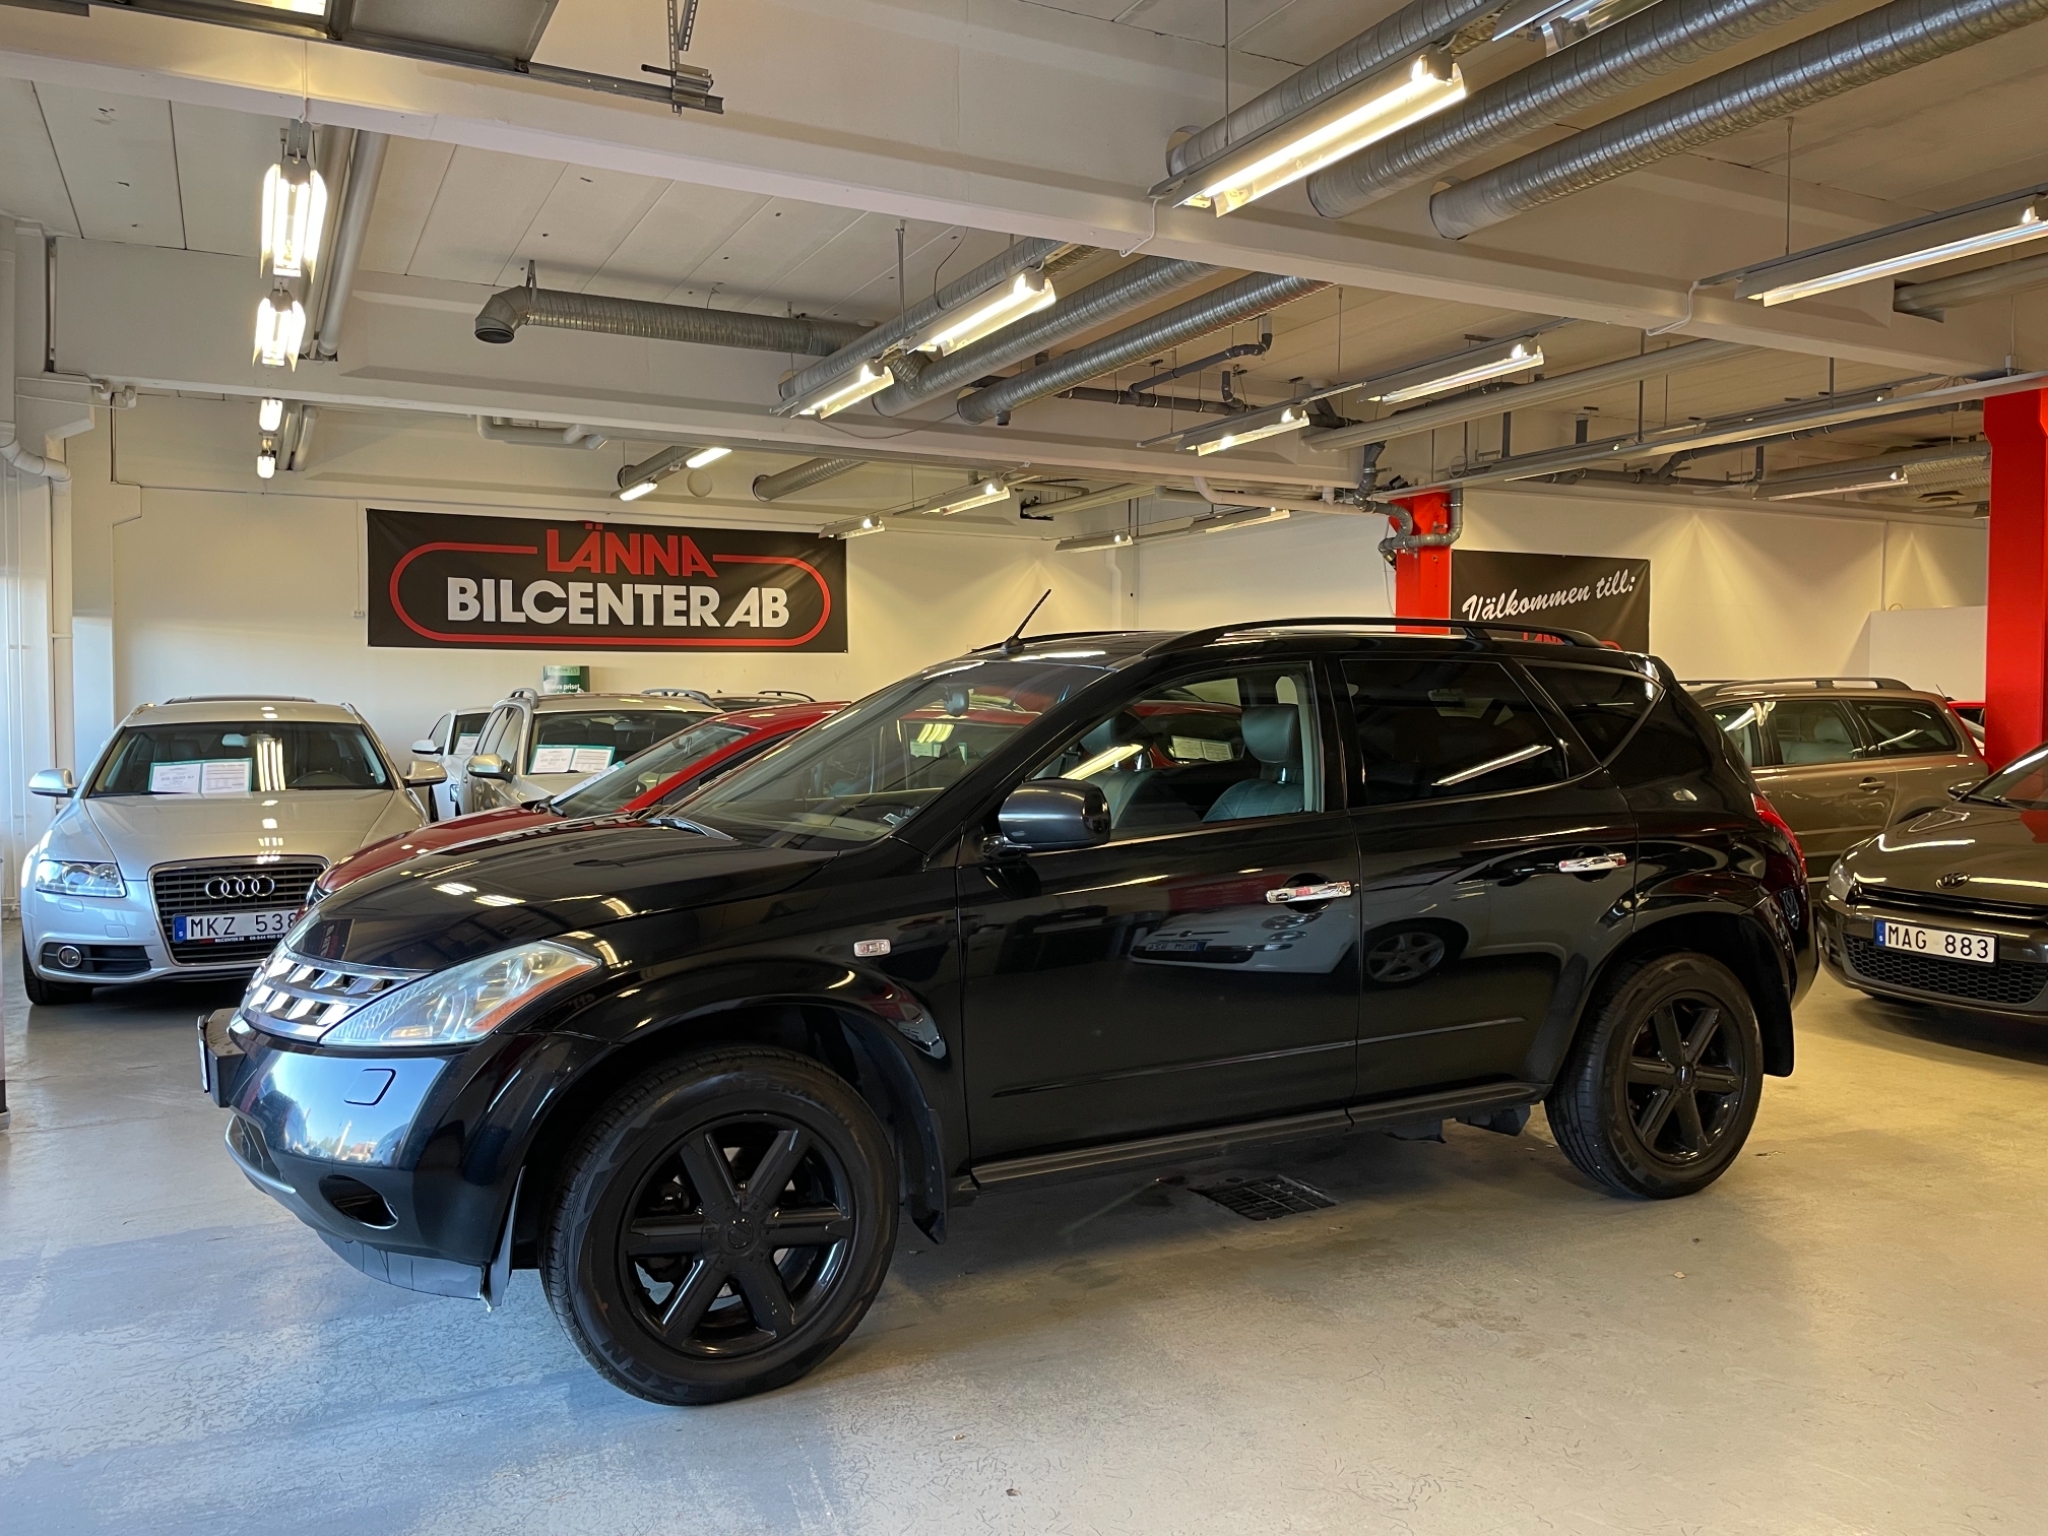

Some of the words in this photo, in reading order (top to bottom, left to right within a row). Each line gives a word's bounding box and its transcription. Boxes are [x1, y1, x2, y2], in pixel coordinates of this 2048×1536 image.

[546, 522, 718, 578] LÄNNA
[447, 577, 721, 627] BILCENTER
[724, 587, 790, 628] AB
[1461, 586, 1591, 622] Välkommen
[1596, 568, 1636, 599] till:
[190, 917, 236, 937] MKZ
[1888, 925, 1927, 950] MAG
[1944, 934, 1988, 958] 883
